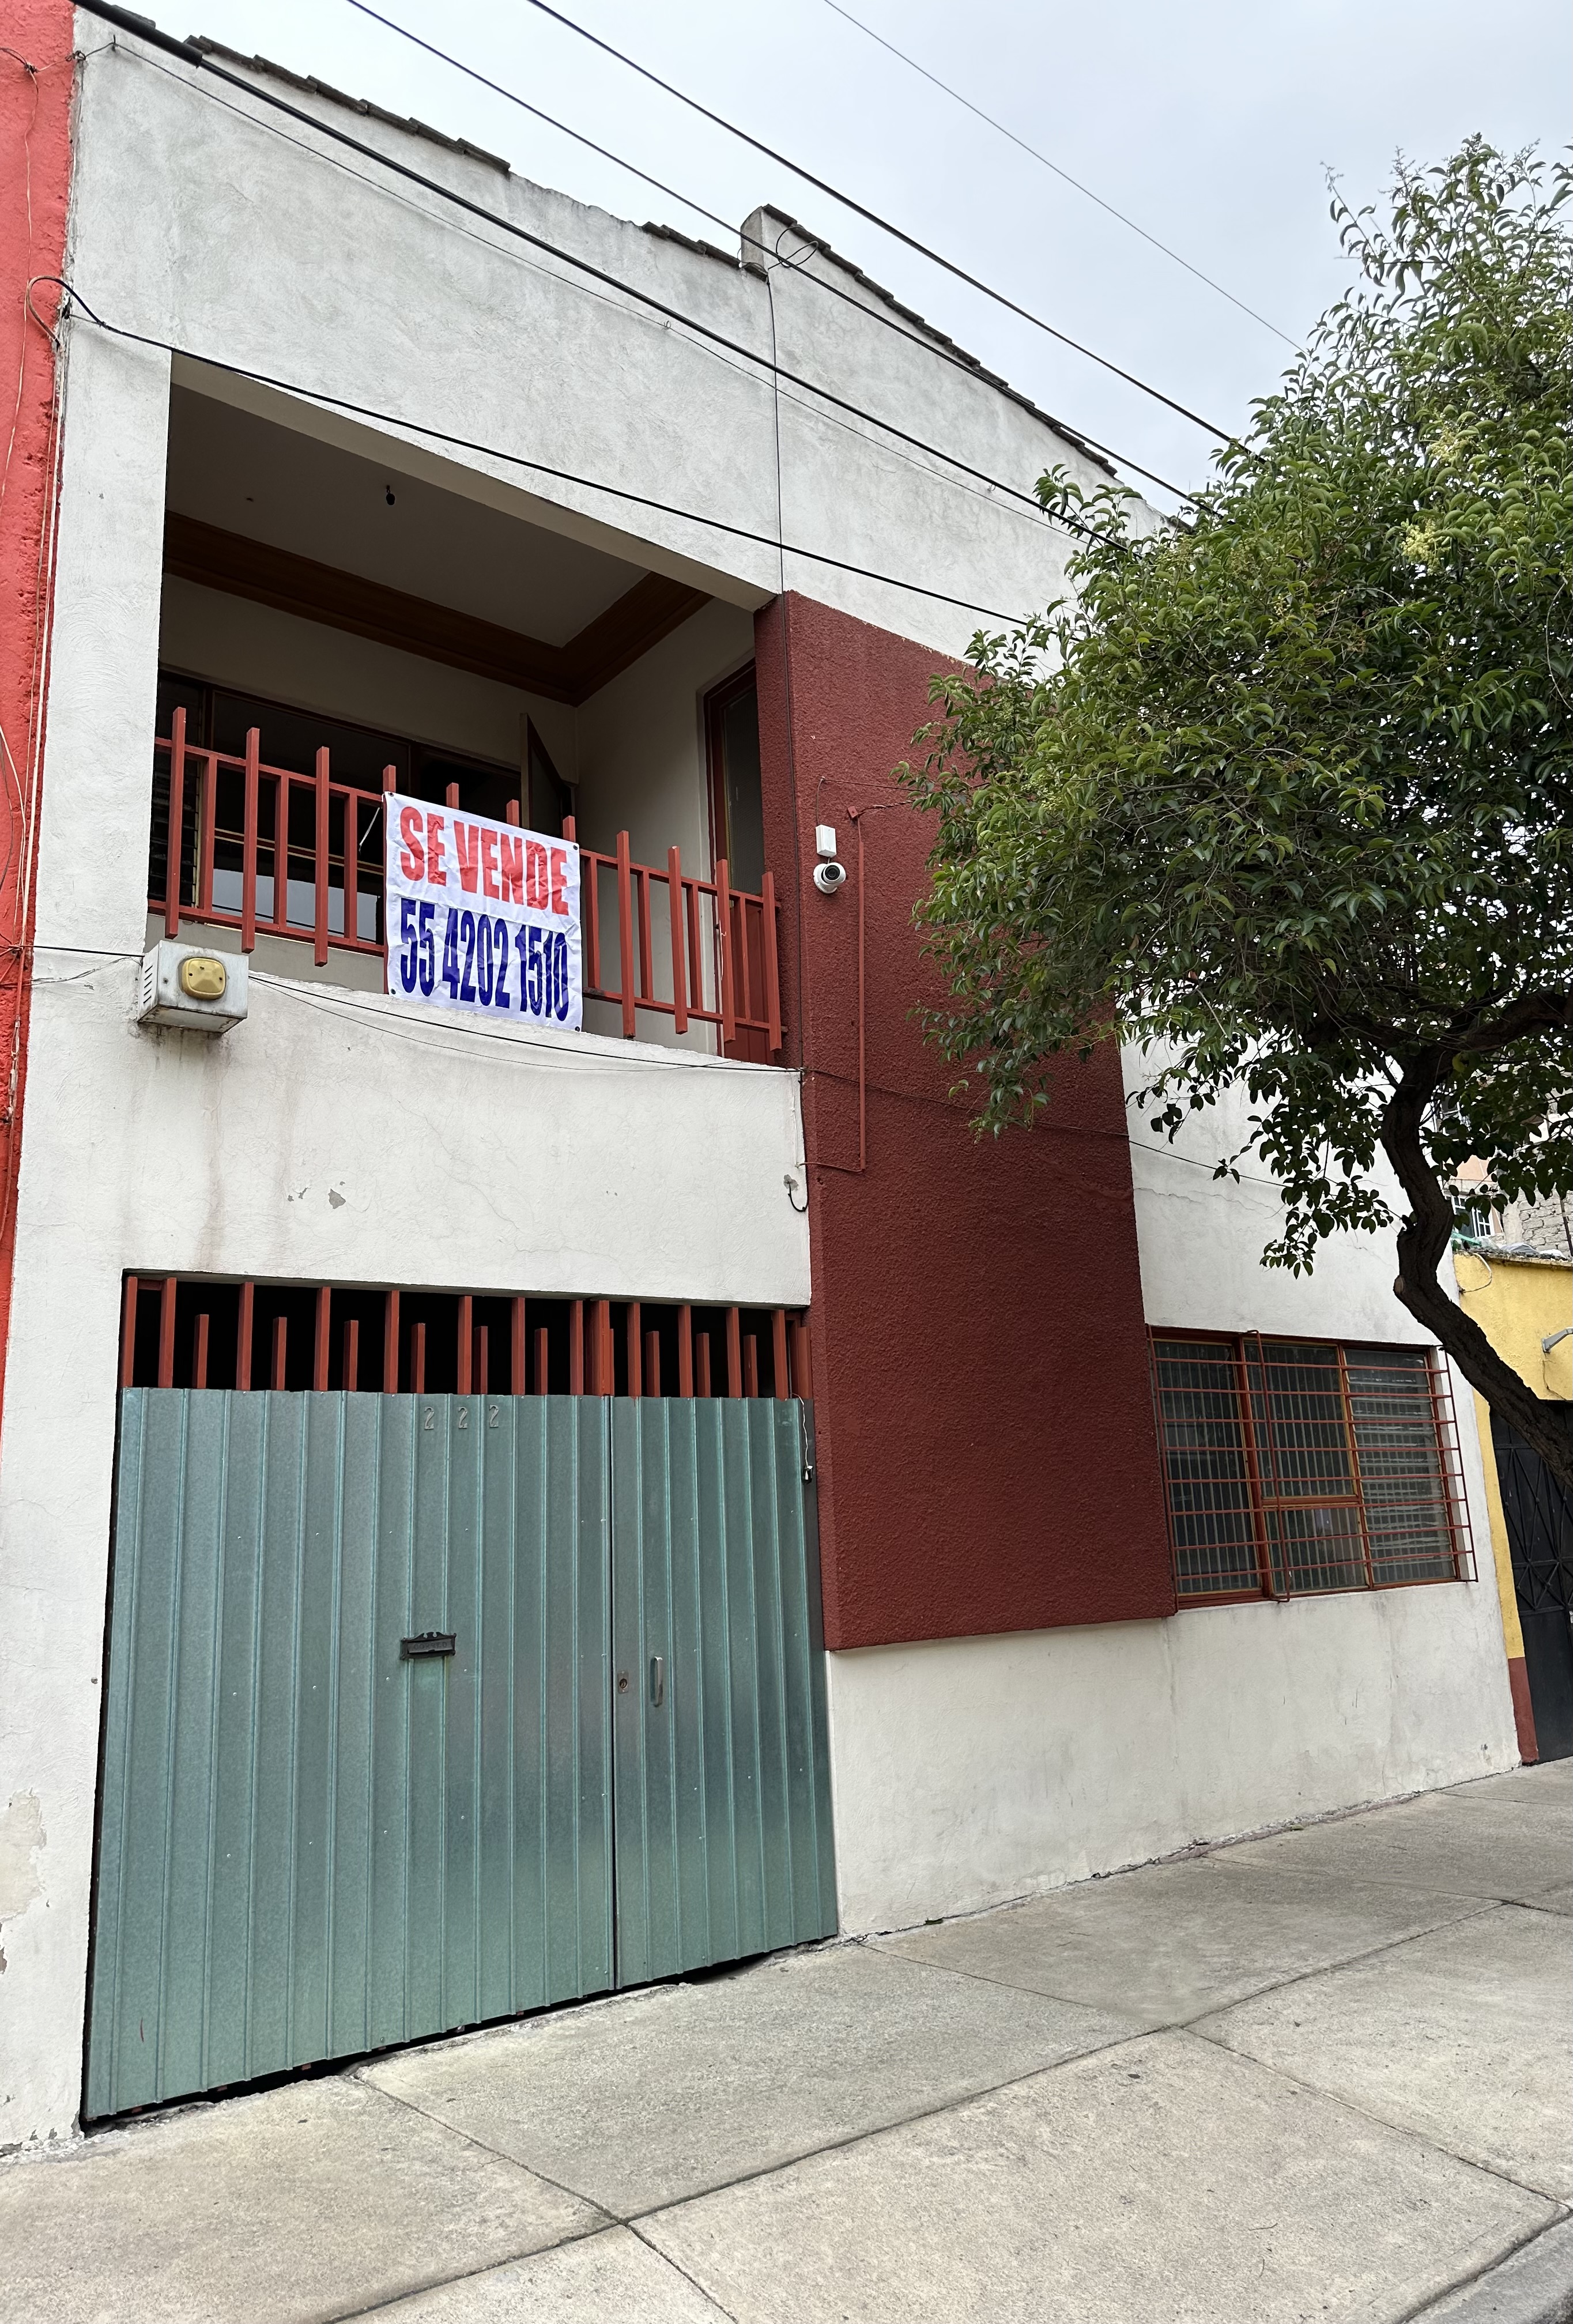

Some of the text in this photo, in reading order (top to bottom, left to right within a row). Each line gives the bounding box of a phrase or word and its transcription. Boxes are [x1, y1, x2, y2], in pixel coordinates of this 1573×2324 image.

[400, 806, 569, 916] SE VENDE
[401, 897, 569, 1021] 55 4202 1510
[424, 1404, 499, 1430] 222
